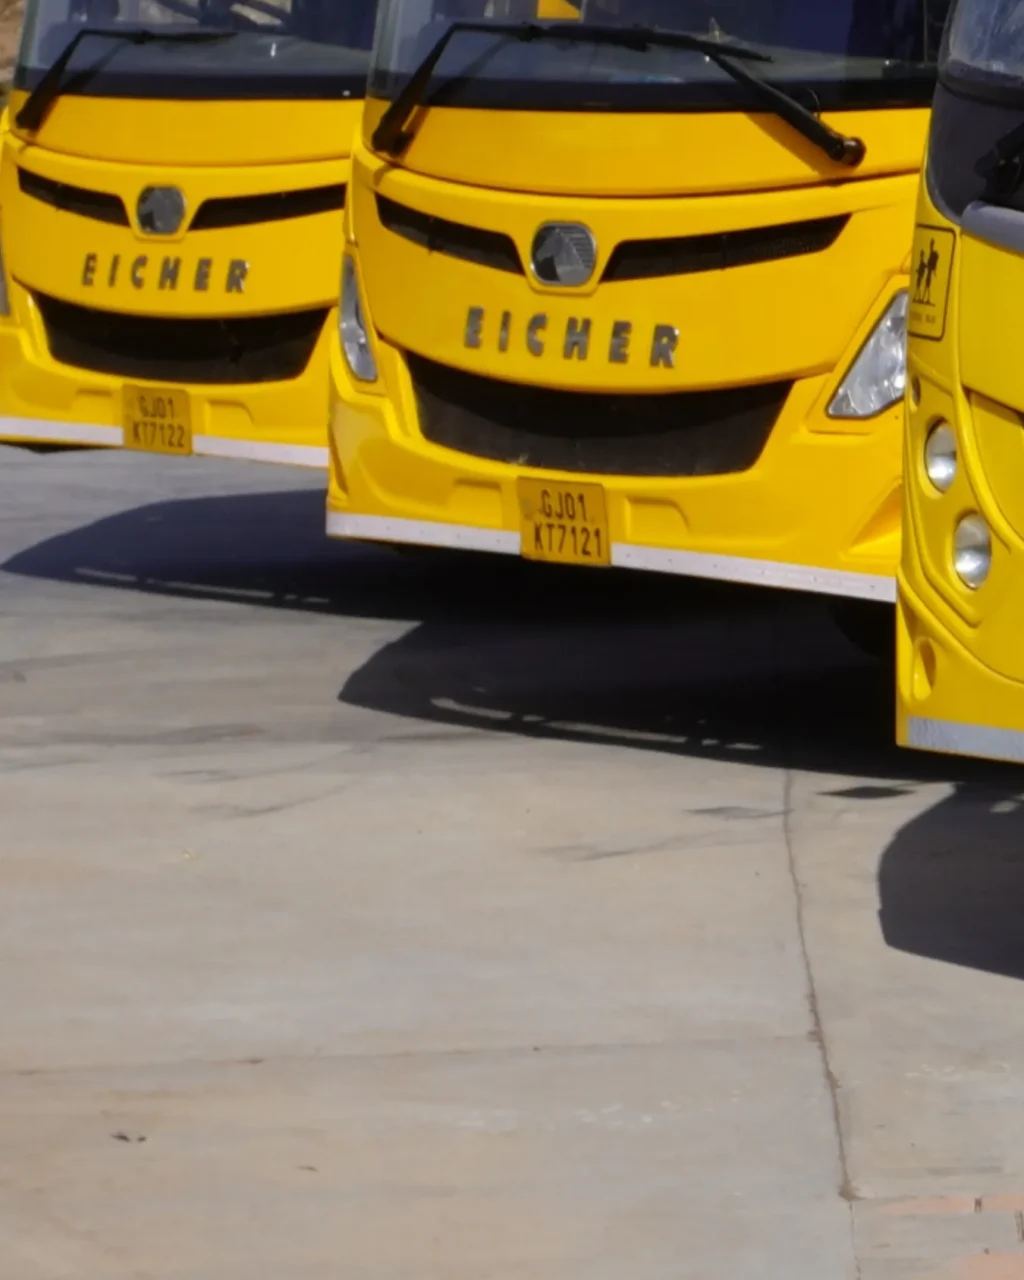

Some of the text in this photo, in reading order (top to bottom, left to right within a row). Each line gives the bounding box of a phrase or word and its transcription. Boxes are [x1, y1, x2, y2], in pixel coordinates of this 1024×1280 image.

[82, 253, 250, 294] EICHER
[463, 306, 680, 369] EICHER
[132, 421, 185, 448] KT7122
[540, 489, 588, 523] GJ01
[533, 523, 602, 558] KT7121
